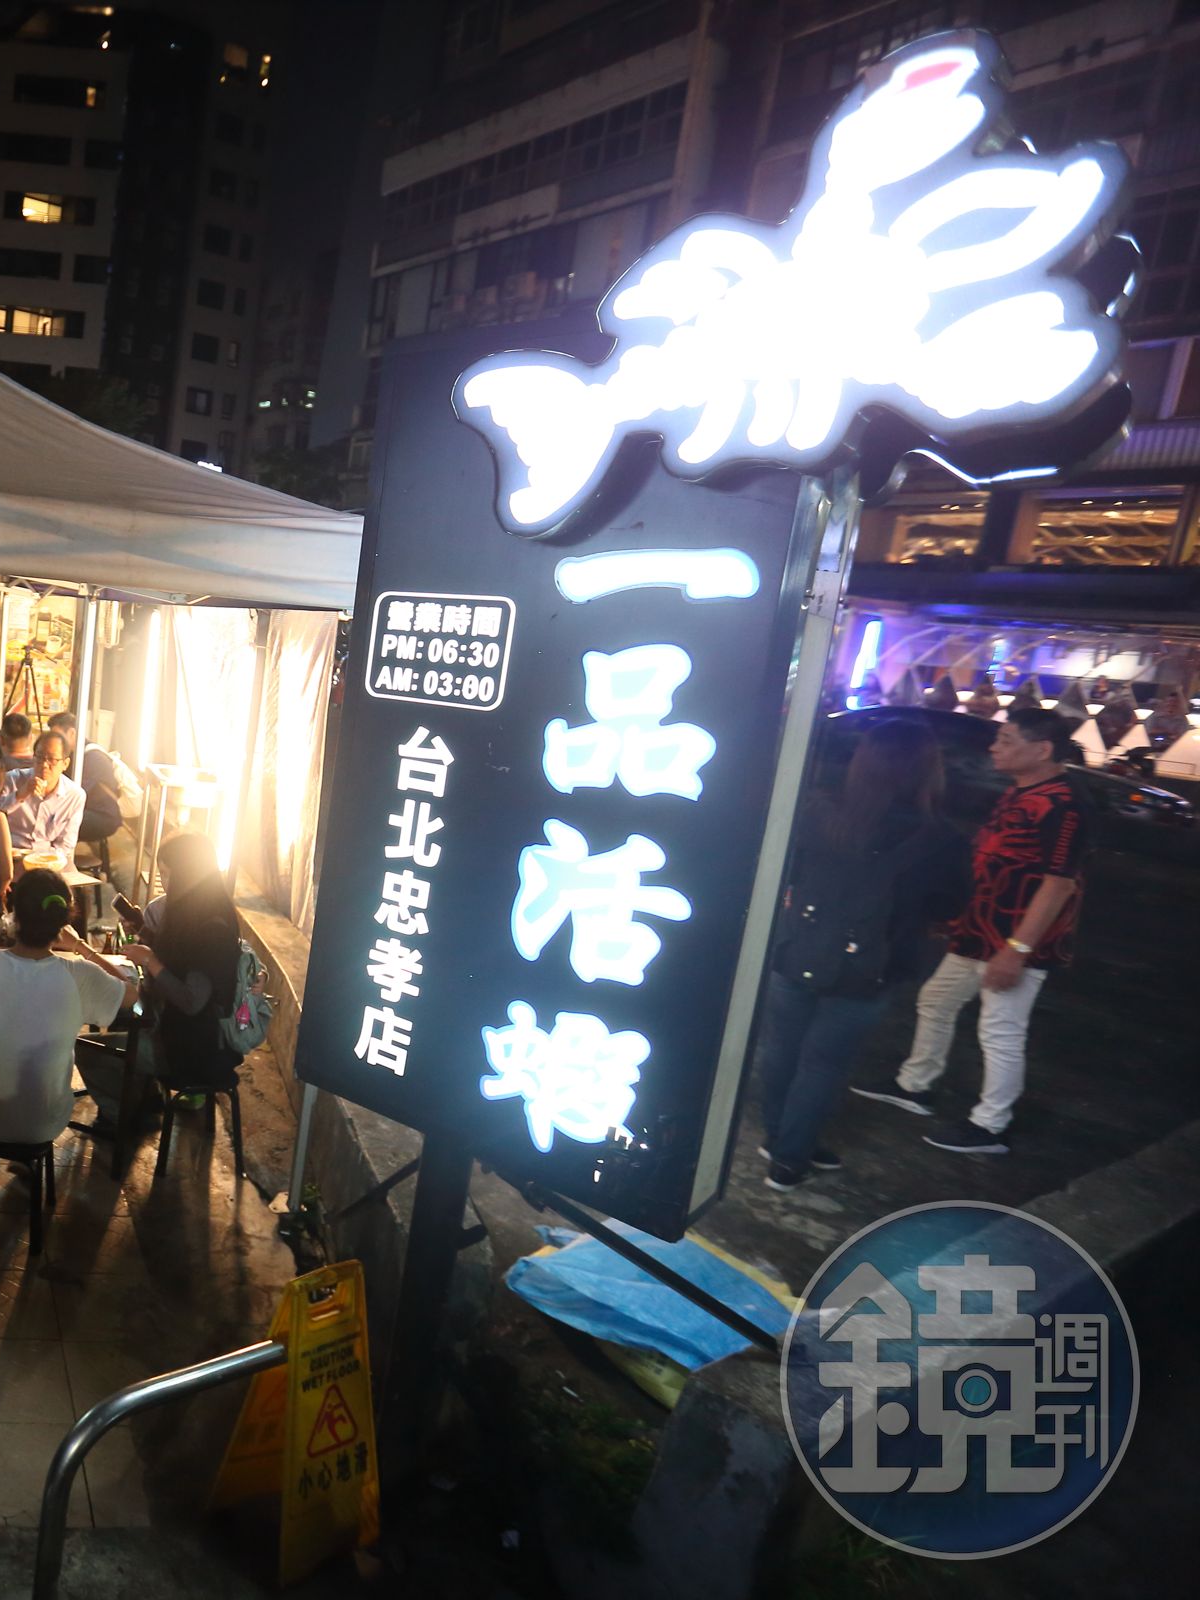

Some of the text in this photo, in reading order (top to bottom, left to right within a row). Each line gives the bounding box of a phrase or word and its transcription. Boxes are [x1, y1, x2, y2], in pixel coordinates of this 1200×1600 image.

[387, 600, 503, 637] 營業時間
[381, 634, 500, 668] PM: 06:30
[375, 665, 419, 692] AM:
[354, 726, 456, 1077] 台北忠孝店
